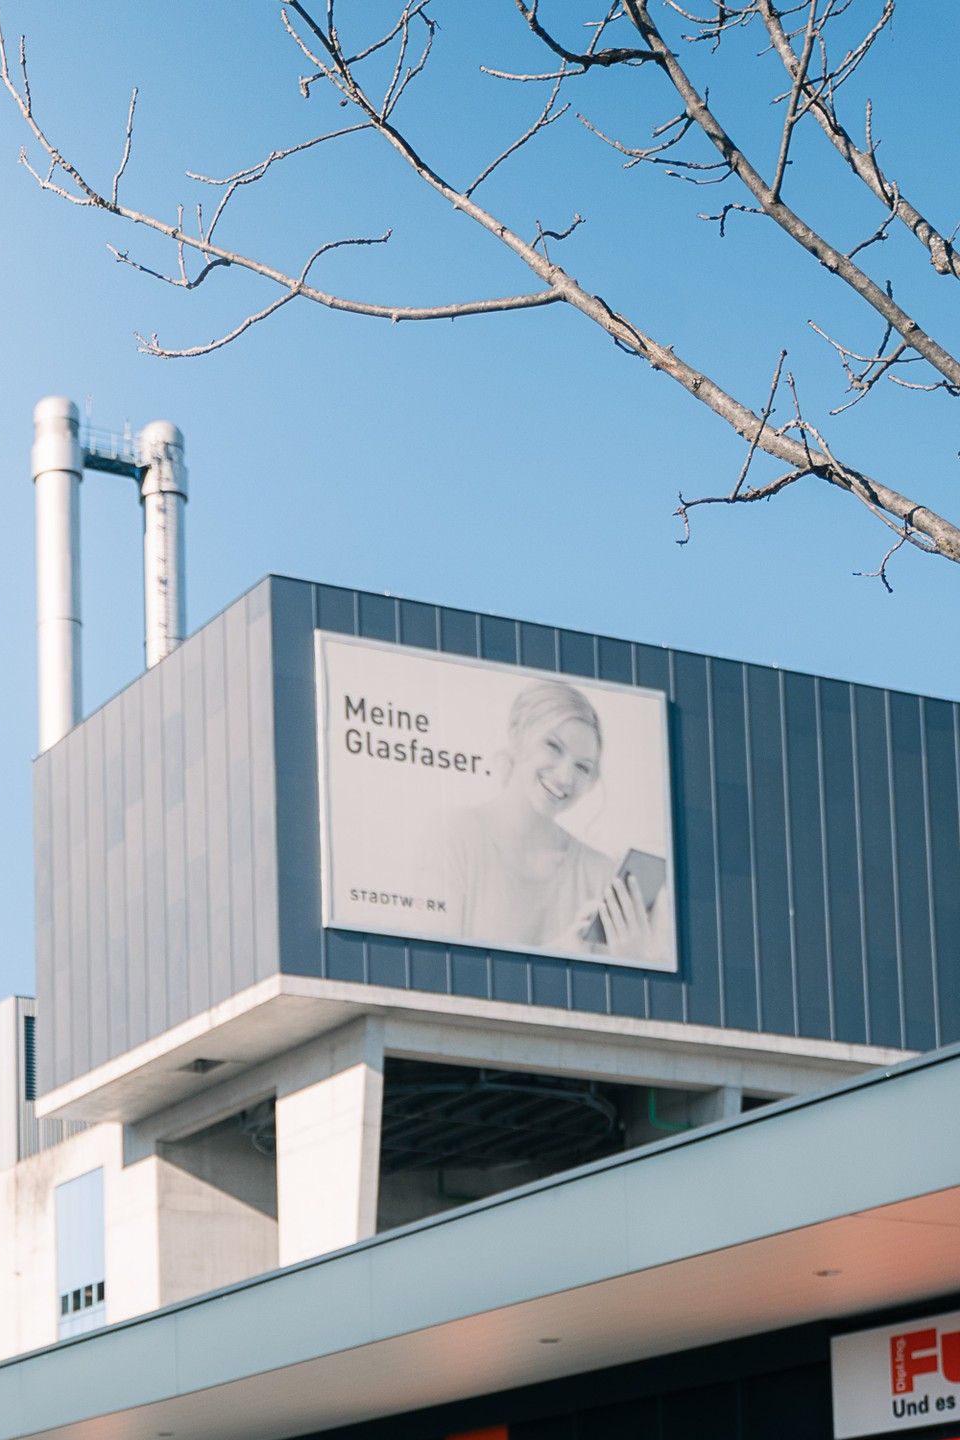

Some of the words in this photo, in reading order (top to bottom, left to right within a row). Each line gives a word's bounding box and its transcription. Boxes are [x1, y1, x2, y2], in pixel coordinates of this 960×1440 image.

[344, 695, 429, 733] Meine
[345, 728, 491, 776] Glasfaser.
[892, 1394, 929, 1418] Und
[935, 1395, 956, 1411] es
